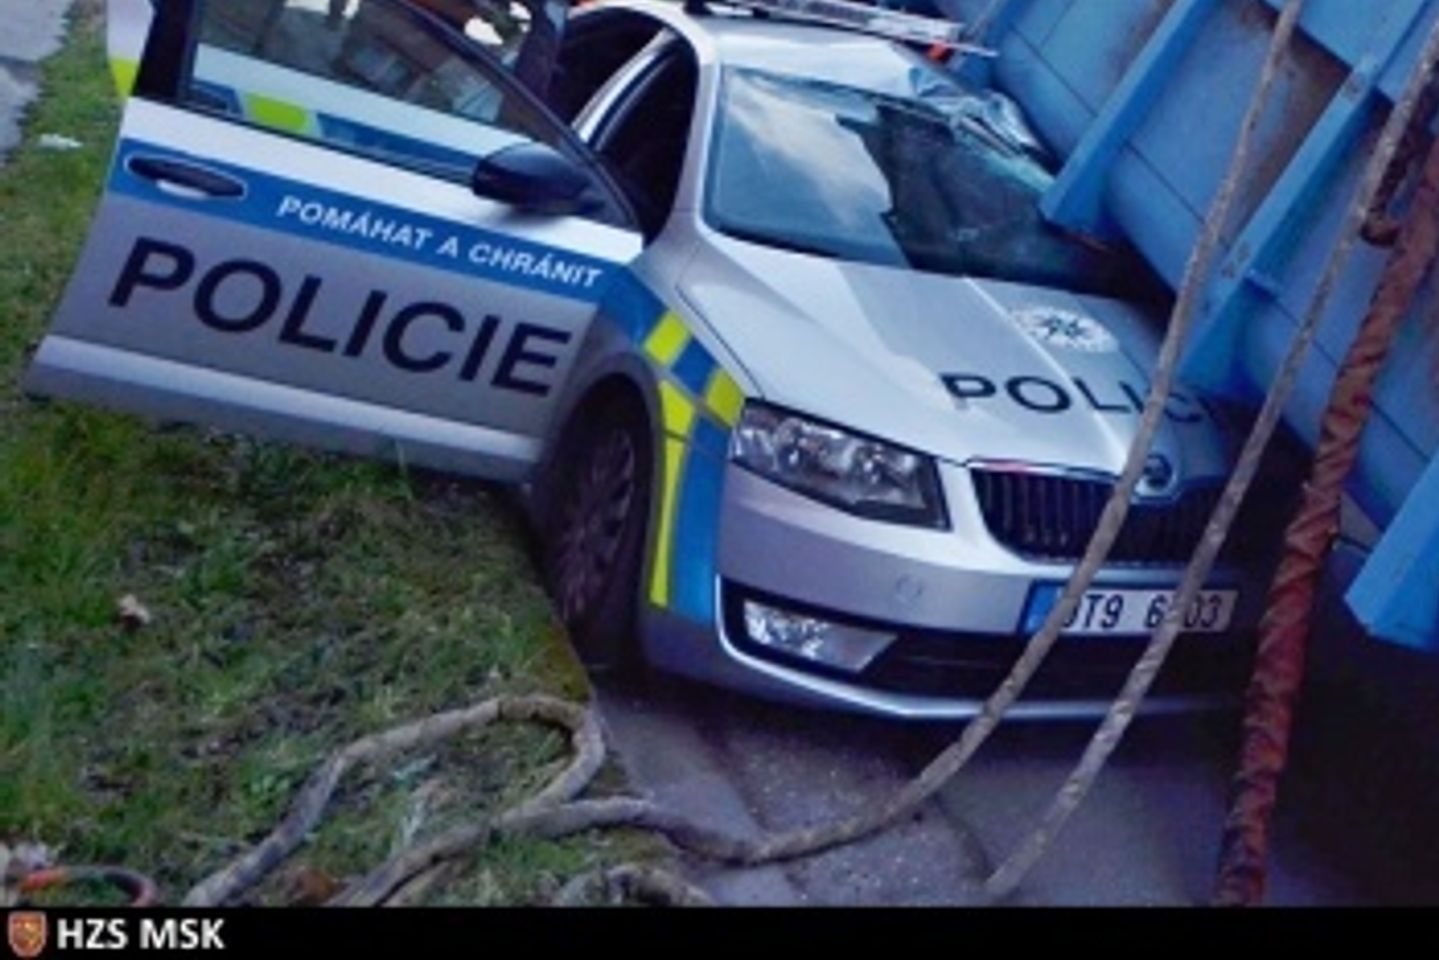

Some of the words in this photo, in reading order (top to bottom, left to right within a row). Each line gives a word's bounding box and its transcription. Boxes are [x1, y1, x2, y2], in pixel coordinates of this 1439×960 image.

[276, 194, 432, 250] POMÁHAT
[436, 236, 460, 257] A
[468, 242, 602, 288] CHRÁNIT
[109, 235, 572, 398] POLICIE
[1144, 594, 1222, 629] 603
